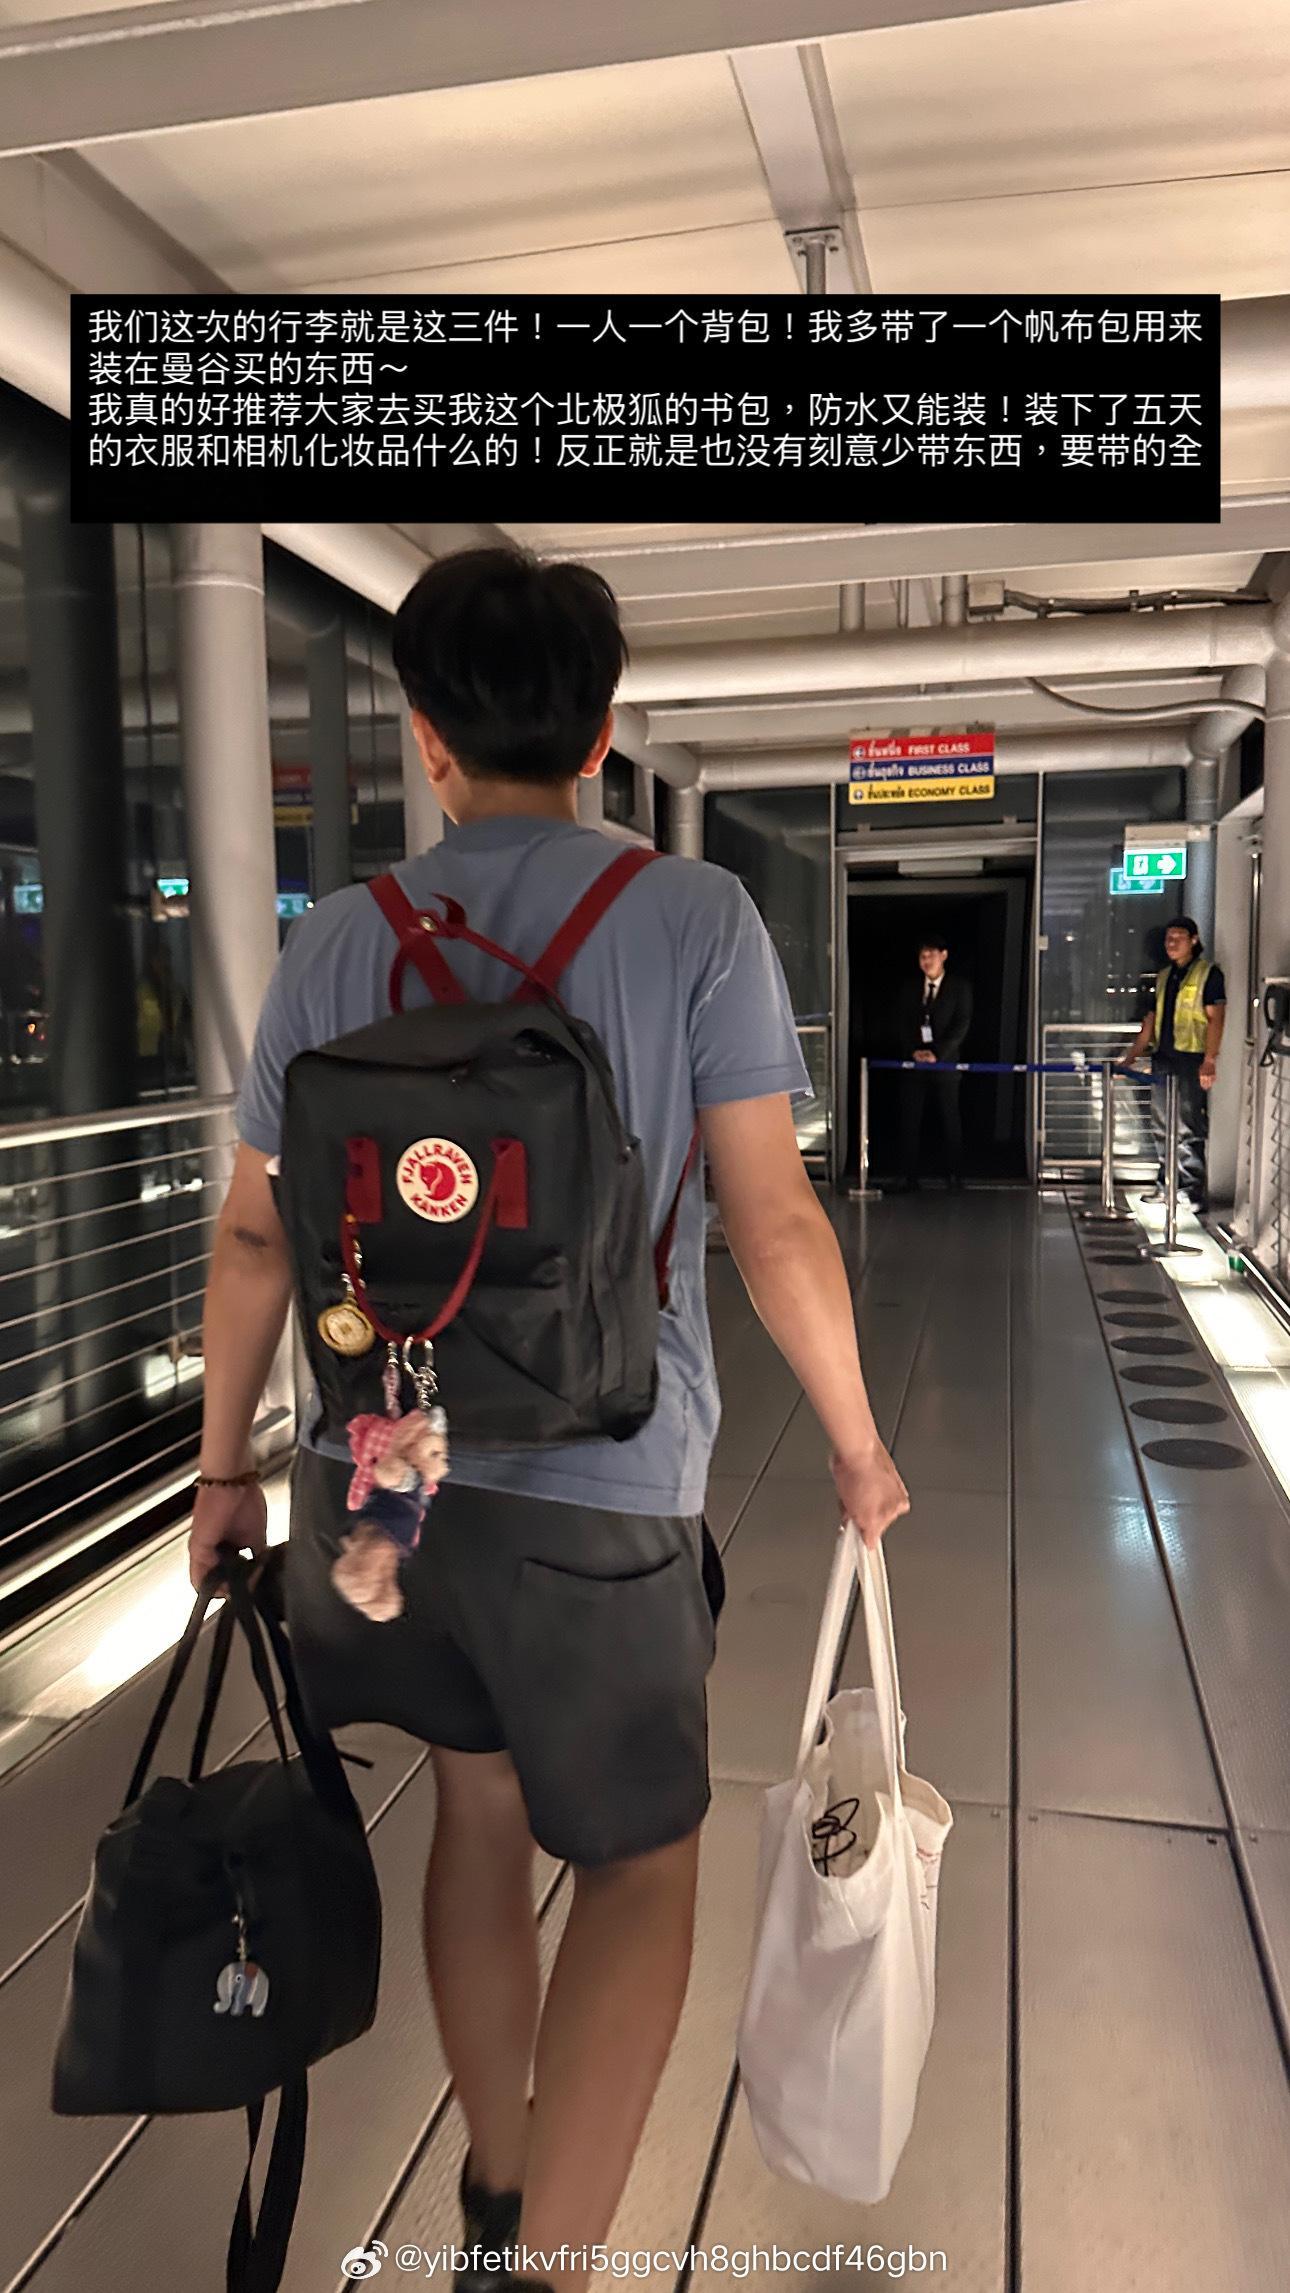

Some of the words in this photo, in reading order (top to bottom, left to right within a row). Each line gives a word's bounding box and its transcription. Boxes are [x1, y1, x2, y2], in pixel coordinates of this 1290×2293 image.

[908, 743, 935, 756] FIRST
[937, 741, 971, 754] CLASS
[908, 762, 955, 777] BUSINESS
[957, 760, 990, 774] CLASS
[908, 785, 956, 798] ECONOMY
[959, 783, 990, 796] CLASS
